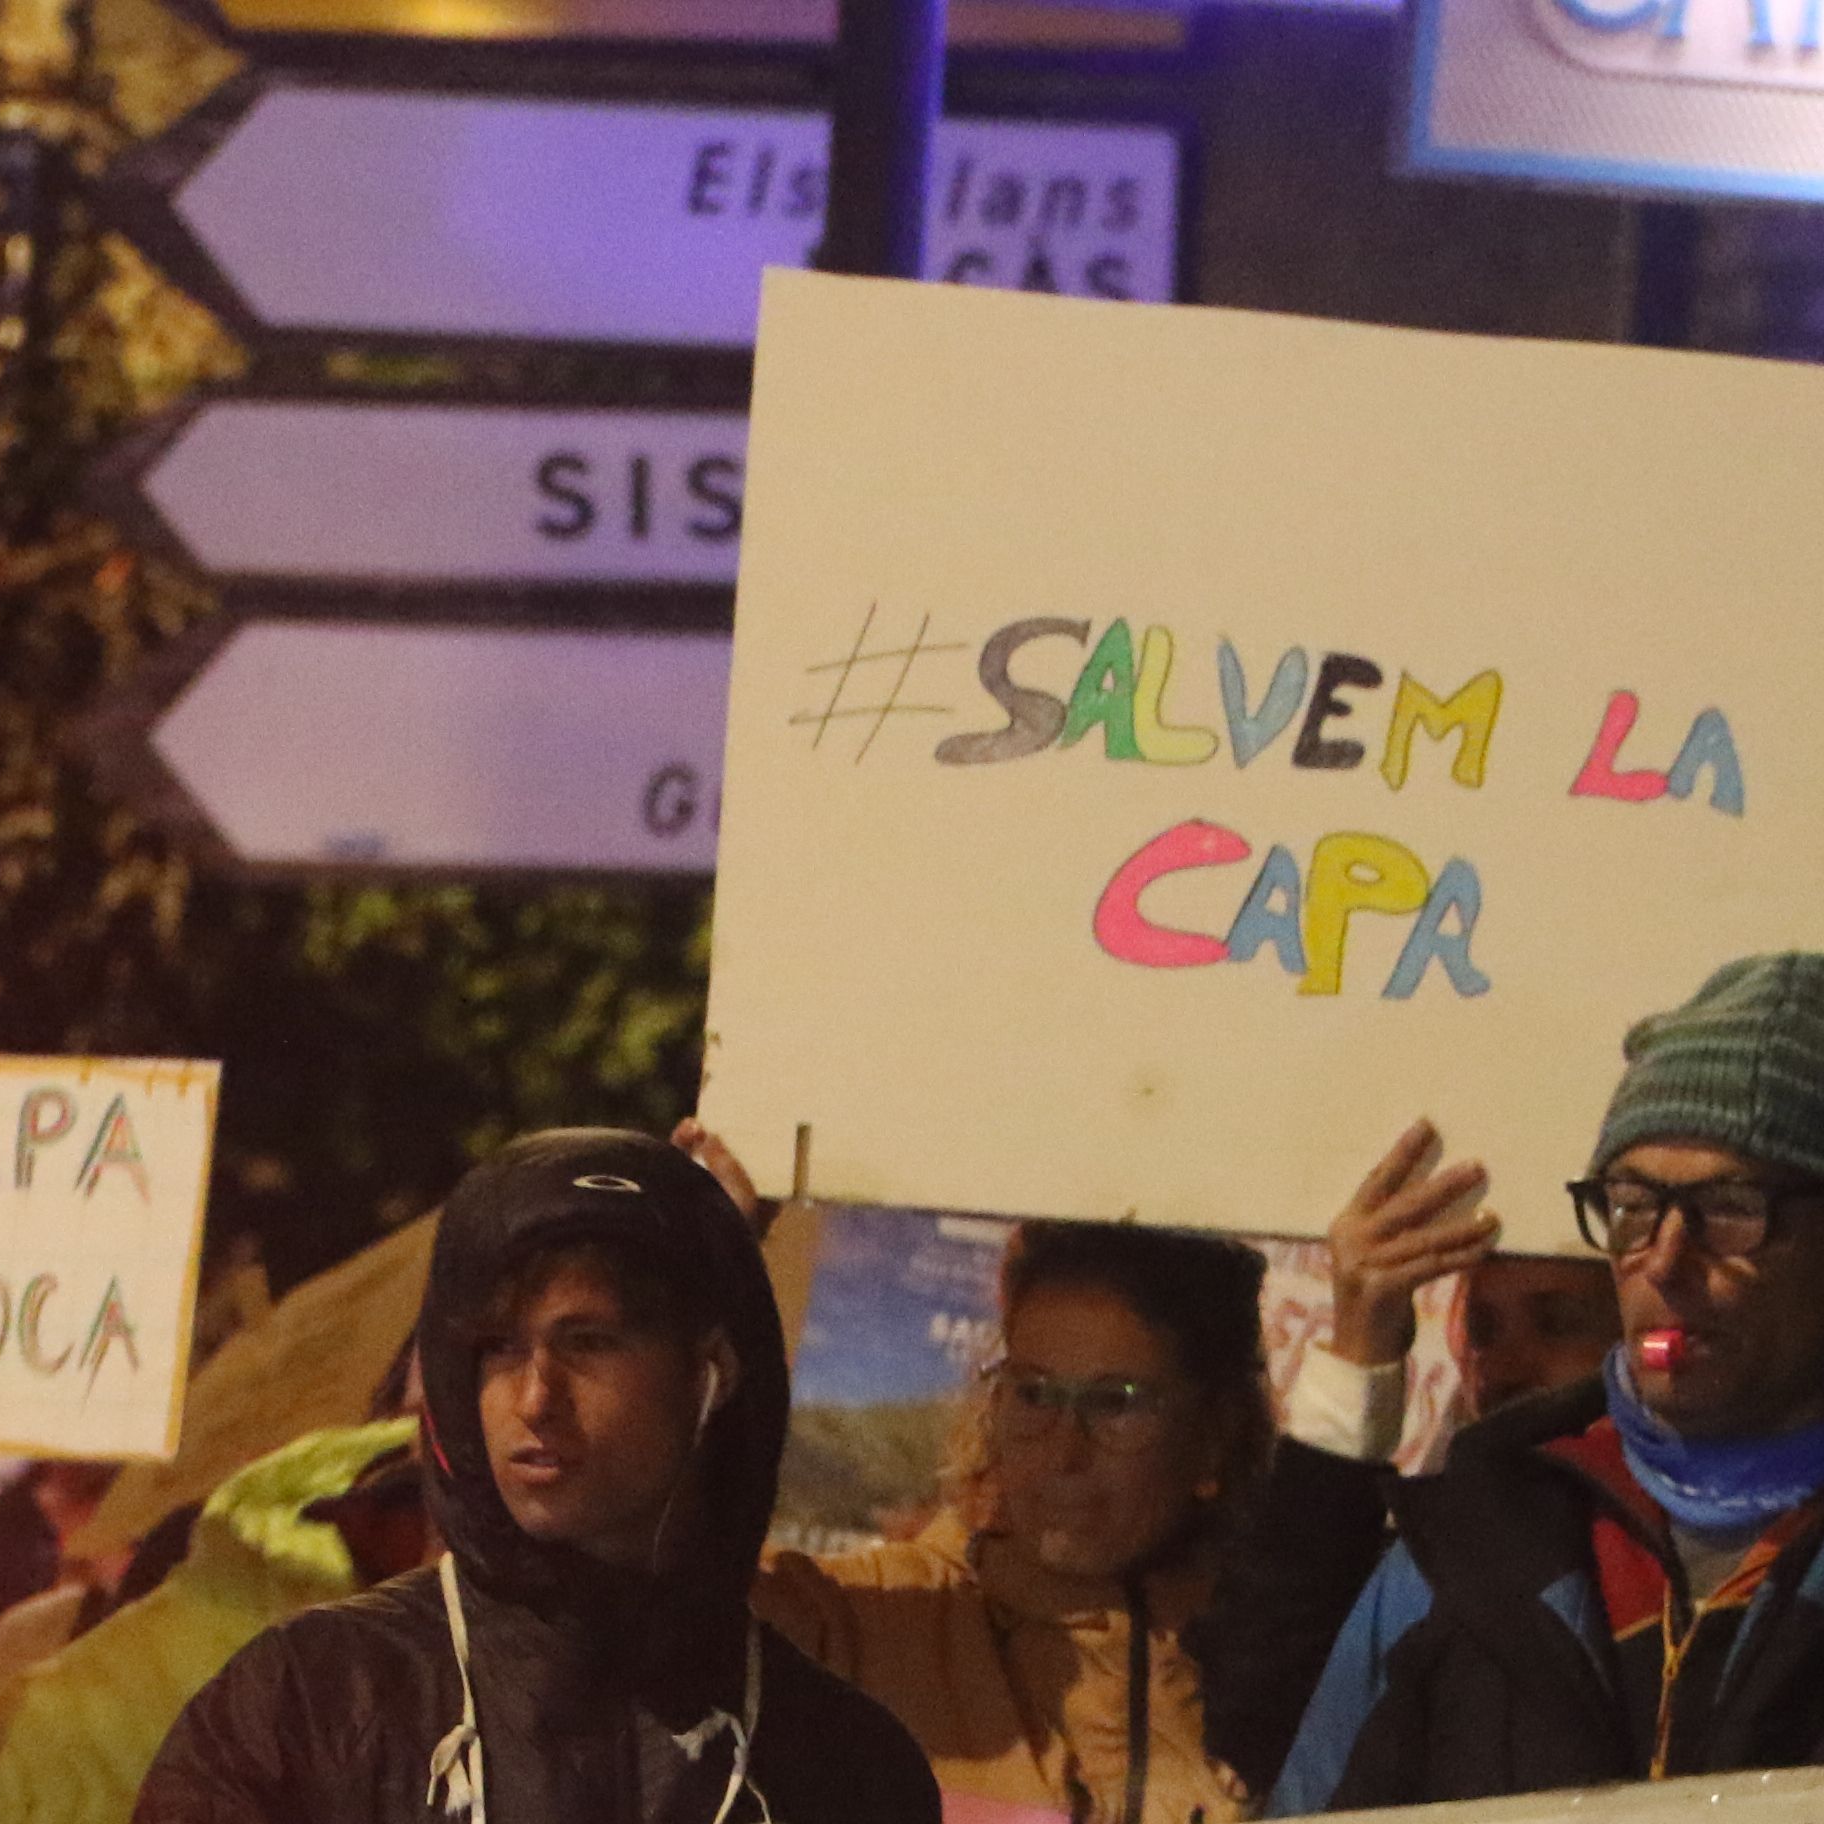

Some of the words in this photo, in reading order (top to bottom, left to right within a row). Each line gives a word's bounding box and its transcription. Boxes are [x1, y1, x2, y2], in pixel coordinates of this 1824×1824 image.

[942, 157, 1144, 233] lans
[788, 601, 1503, 790] #SALVEM
[1567, 689, 1745, 817] LA
[1092, 818, 1491, 999] CAPA
